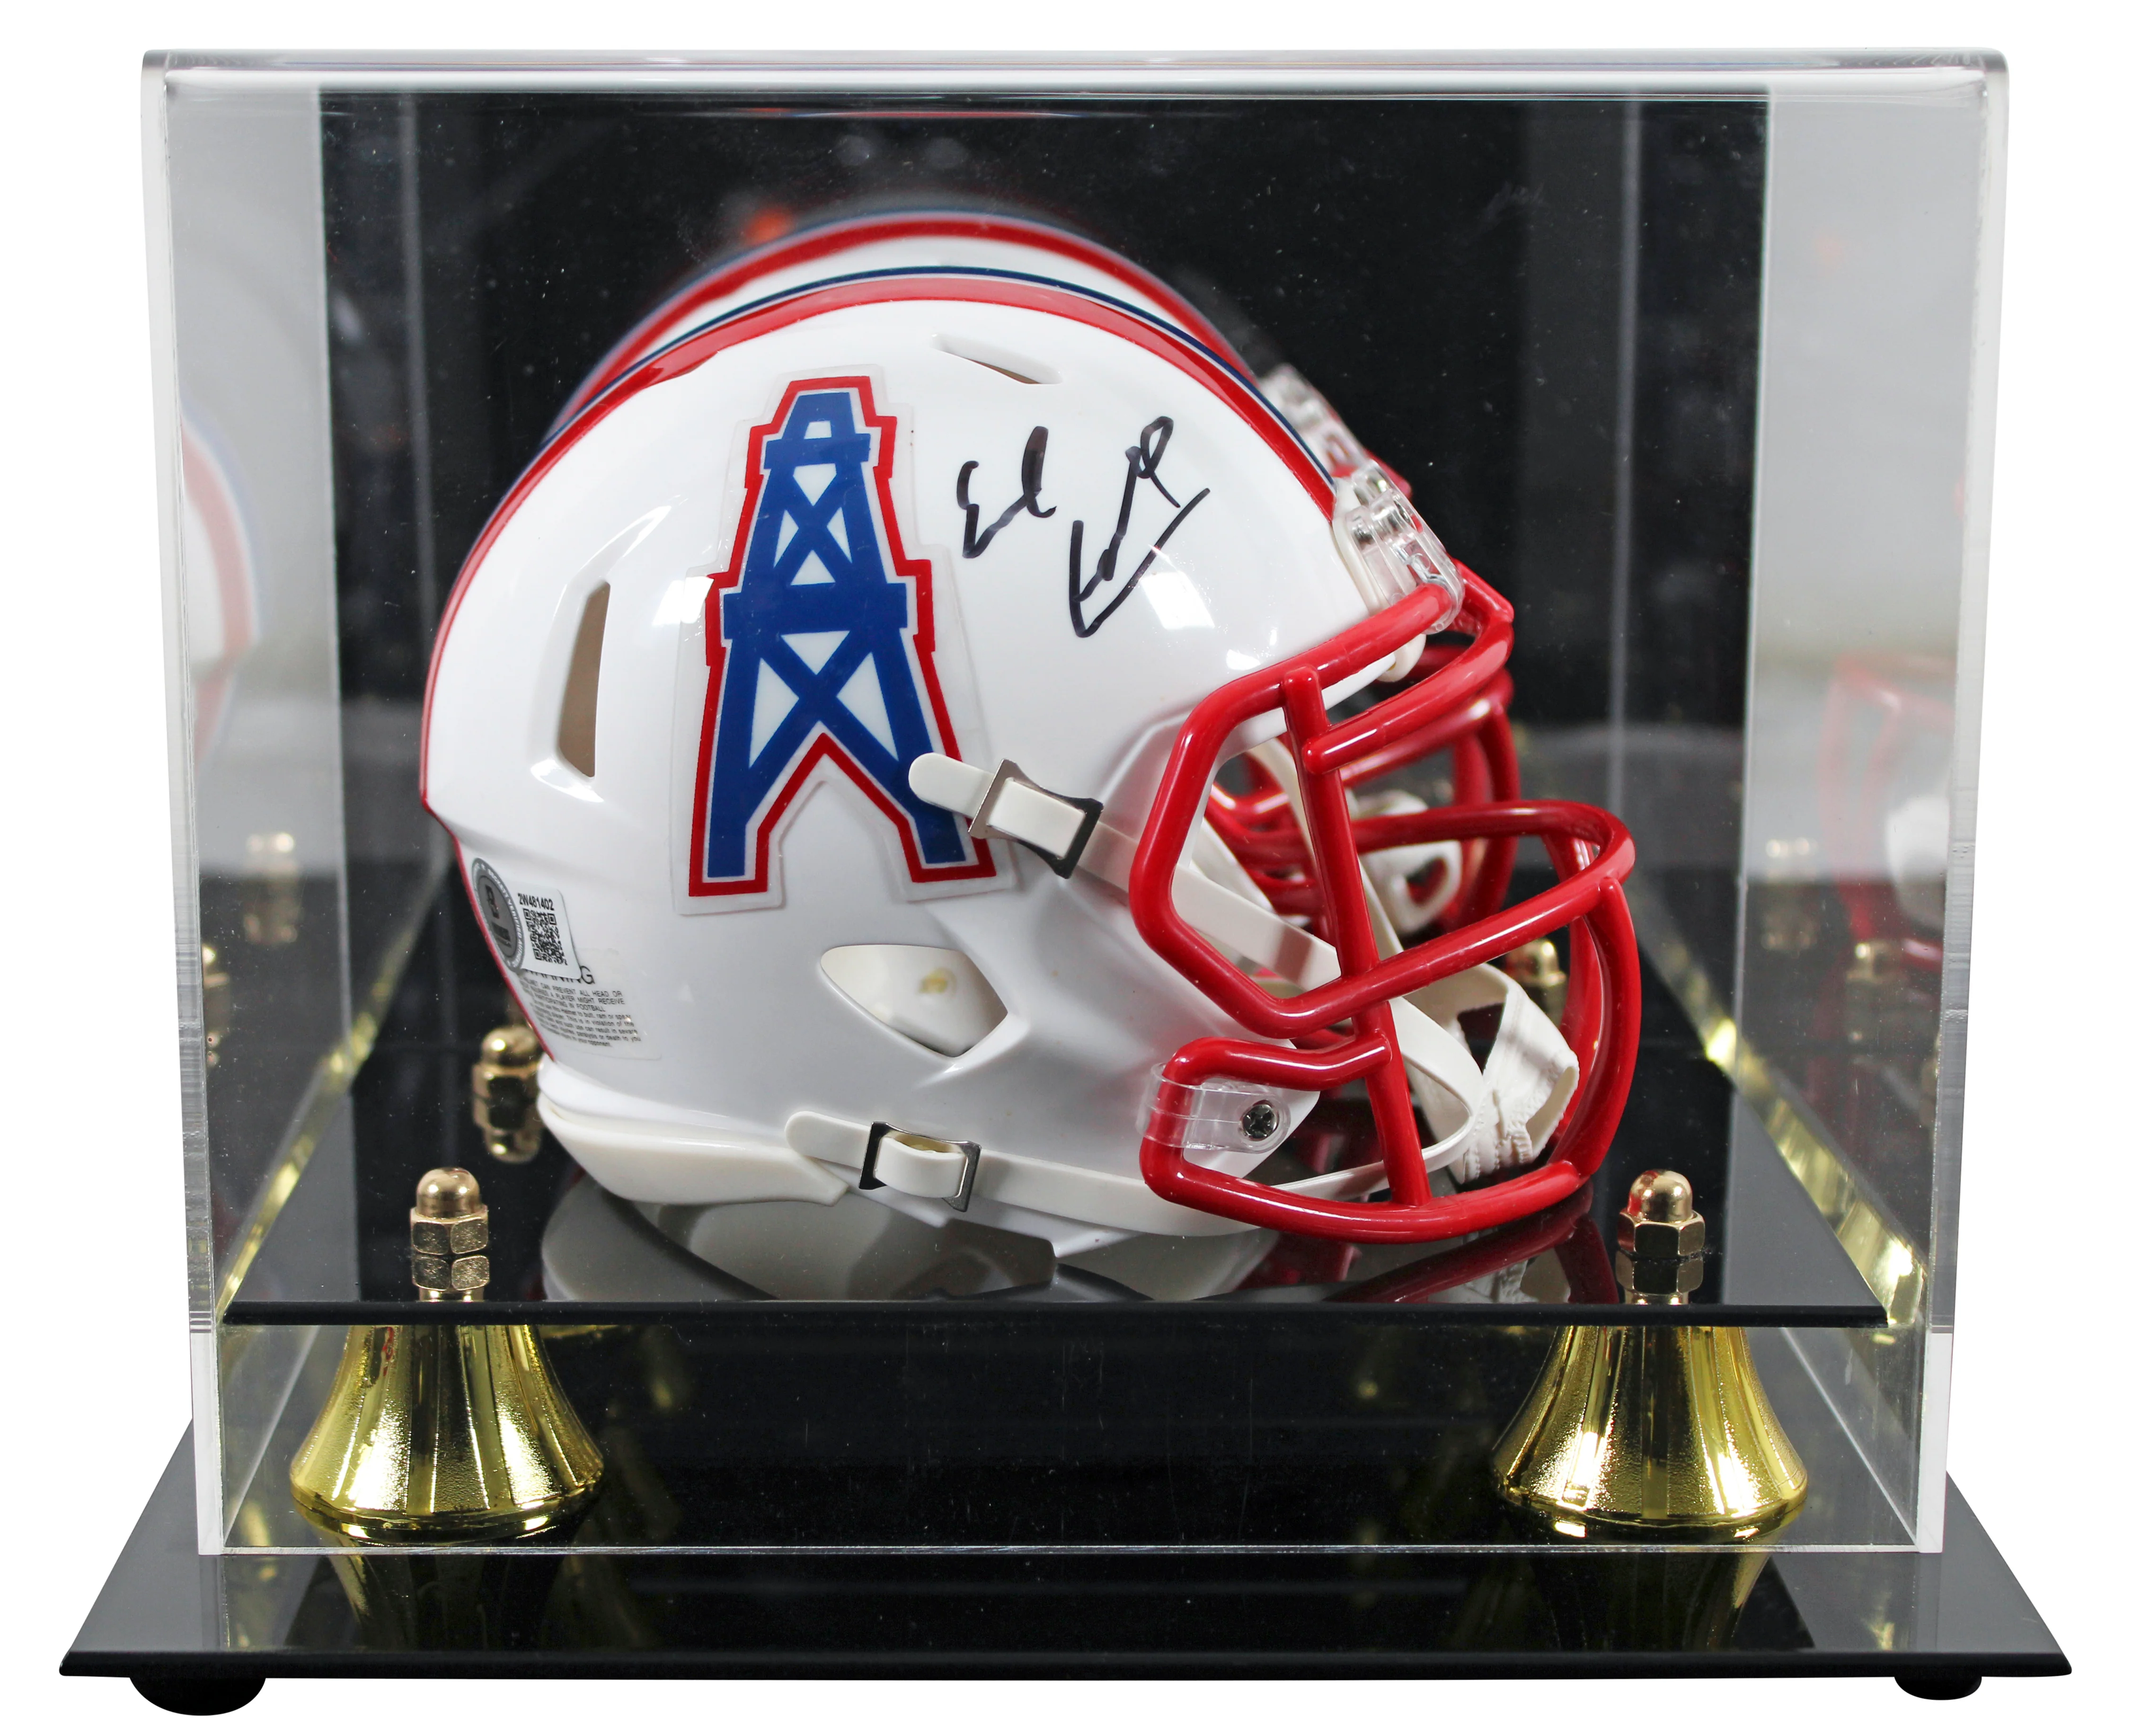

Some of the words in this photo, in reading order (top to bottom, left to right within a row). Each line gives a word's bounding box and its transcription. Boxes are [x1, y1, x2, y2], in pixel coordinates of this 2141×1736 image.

[517, 892, 555, 912] 2W481402
[552, 985, 576, 995] PREVENT
[555, 992, 576, 1002] PLAYER
[576, 1003, 606, 1012] FOOTBALL
